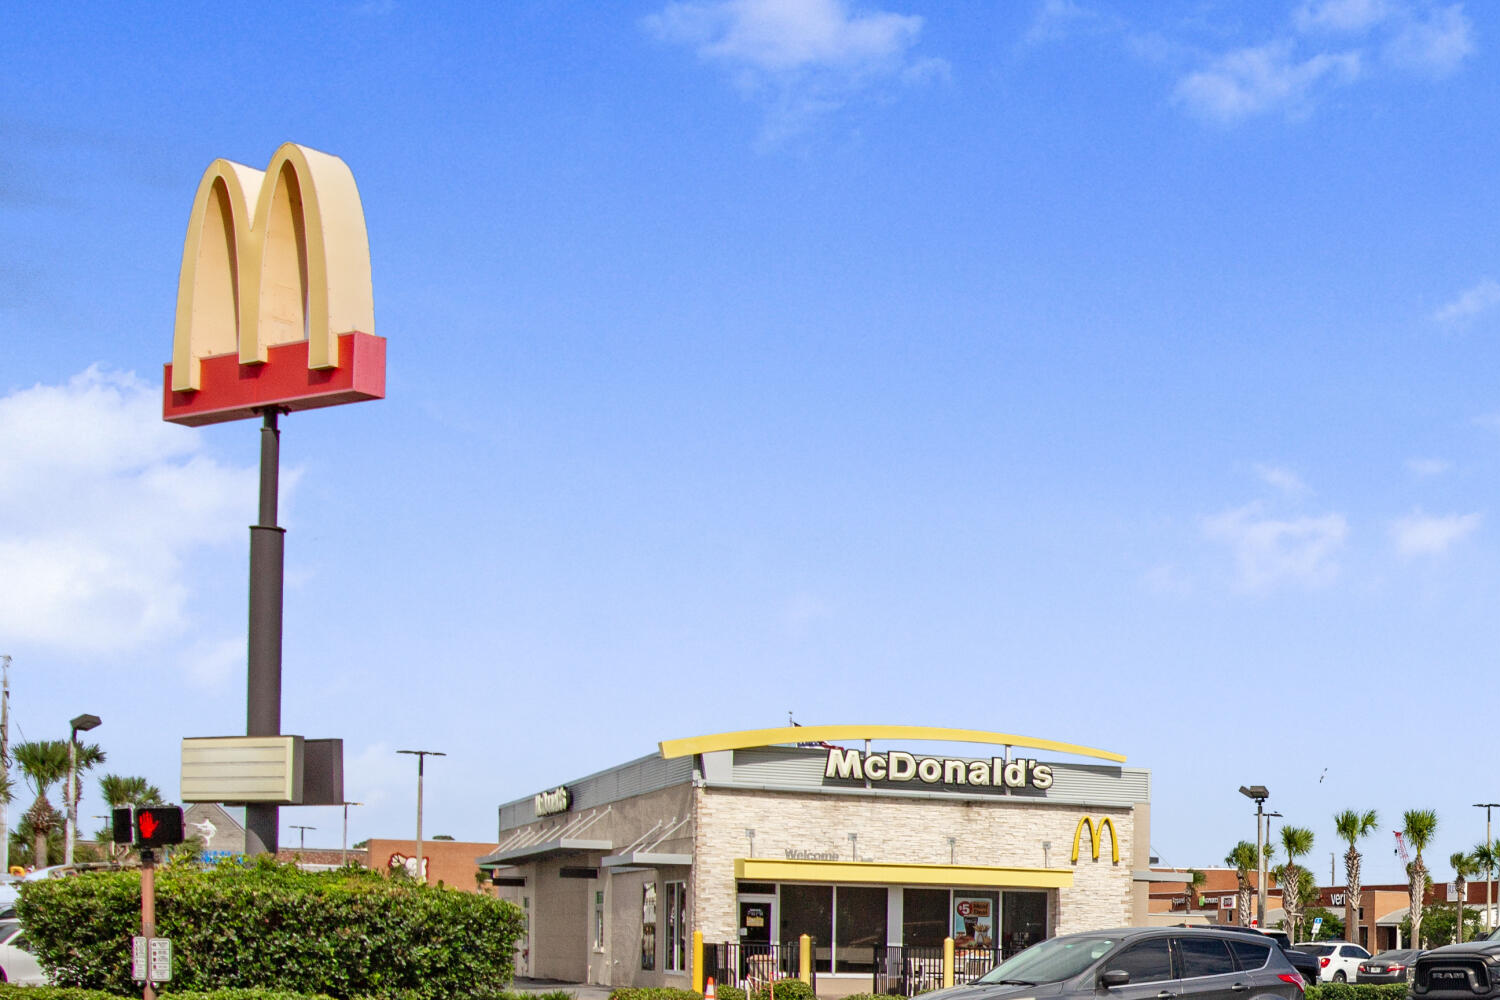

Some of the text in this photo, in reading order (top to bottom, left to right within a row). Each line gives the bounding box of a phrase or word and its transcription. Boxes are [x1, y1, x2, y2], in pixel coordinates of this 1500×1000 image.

[825, 749, 1053, 790] McDonald's
[785, 849, 839, 861] Welcome
[1331, 890, 1346, 905] veri
